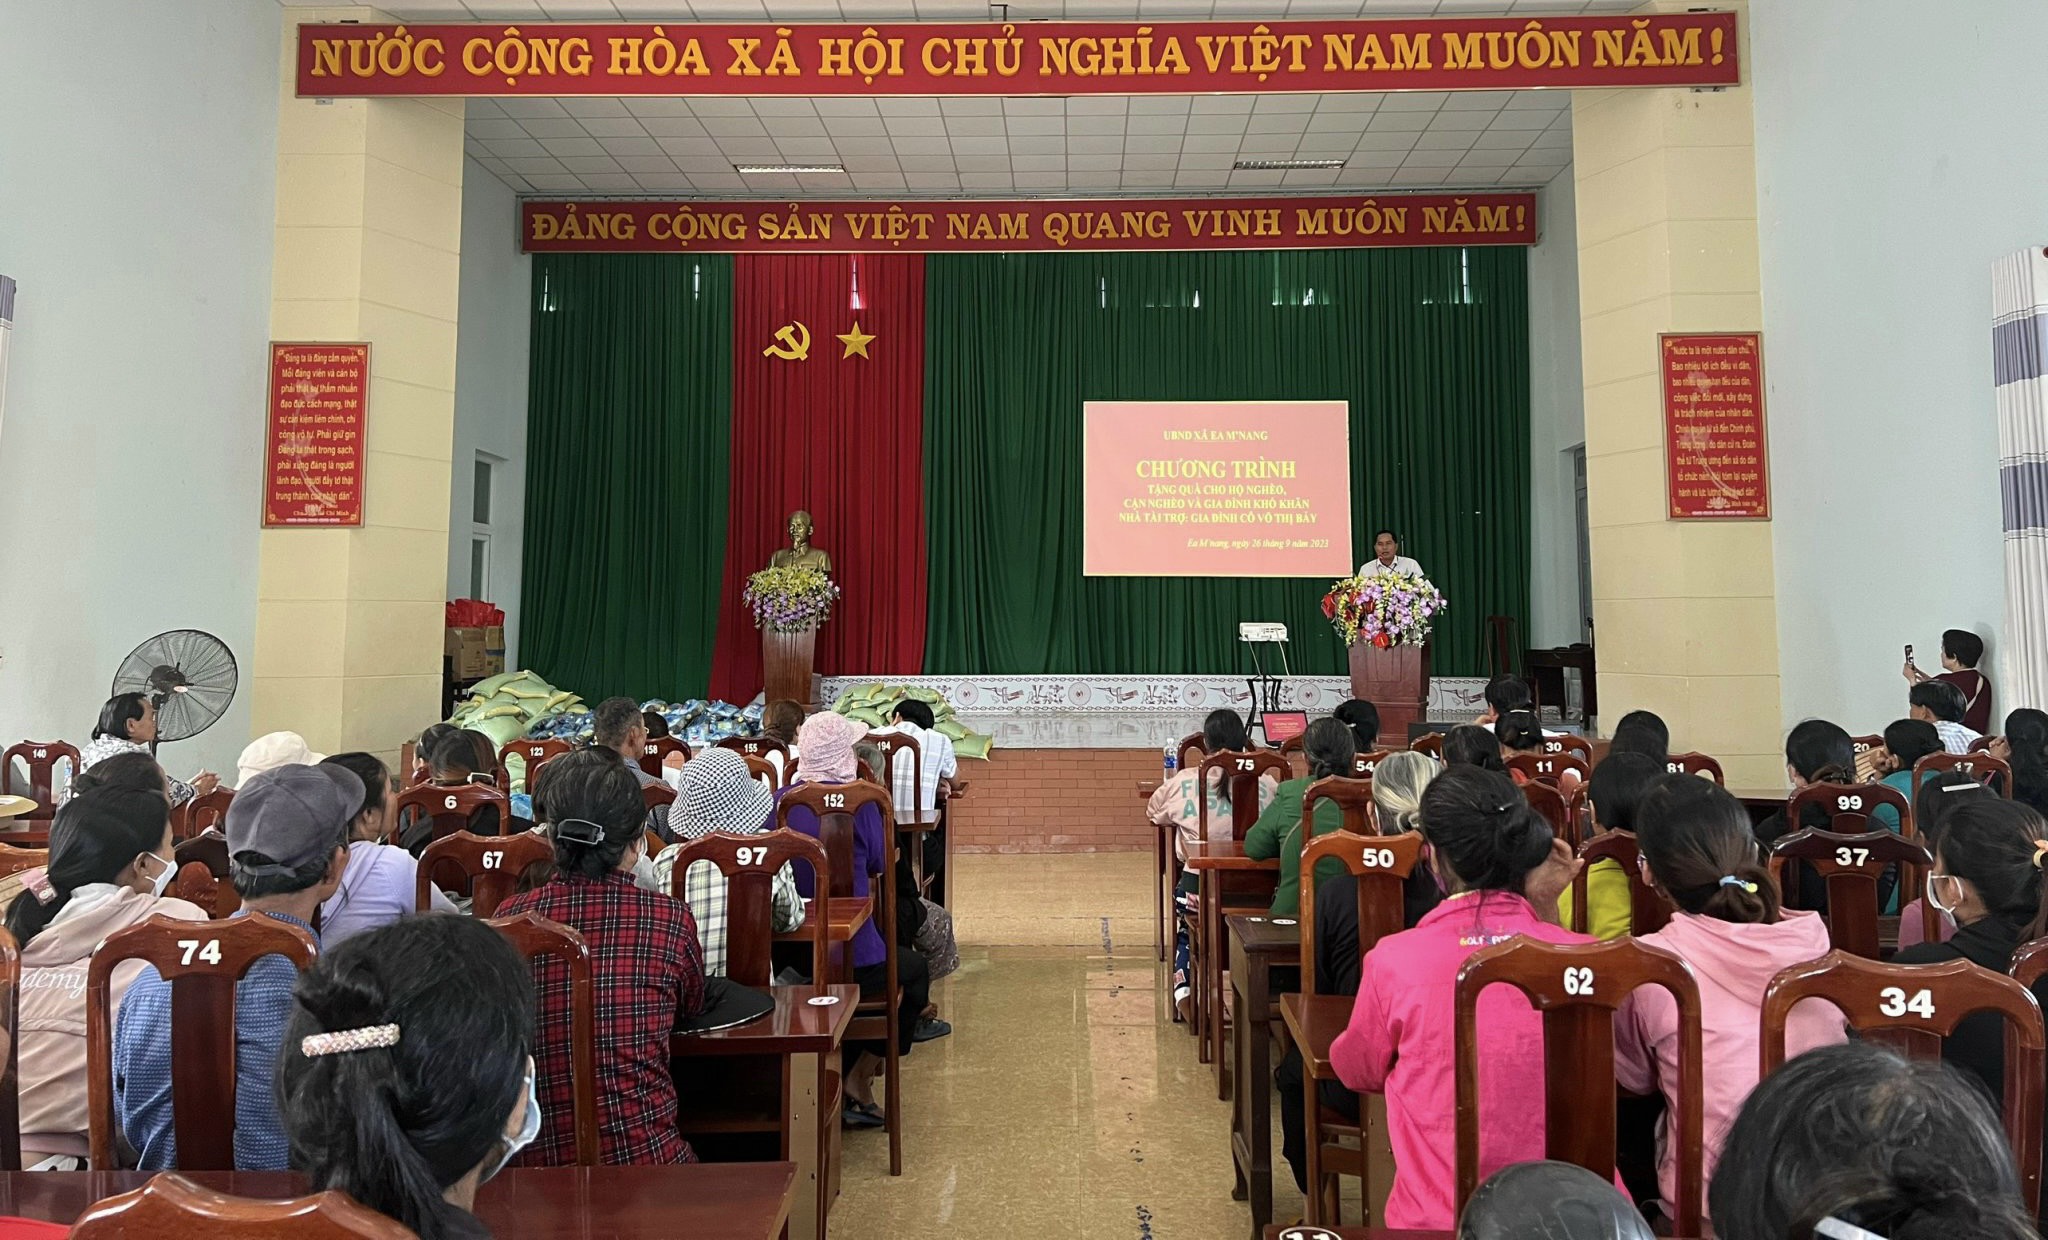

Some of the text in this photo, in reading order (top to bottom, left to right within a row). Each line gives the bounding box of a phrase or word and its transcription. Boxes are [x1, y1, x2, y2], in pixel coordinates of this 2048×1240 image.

[311, 26, 446, 77] NƯỚC
[462, 26, 594, 86] CỘNG
[607, 26, 711, 76] HÒA
[727, 27, 800, 76] XÃ
[818, 27, 904, 85] HỘI
[921, 24, 1024, 76] CHỦ
[1039, 26, 1191, 76] NGHĨA
[1195, 24, 1313, 82] VIỆT
[1323, 32, 1432, 72] NAM
[1443, 20, 1582, 71] MUÔN
[532, 203, 637, 240] ĐẢNG
[648, 205, 747, 246] CỘNG
[758, 203, 832, 240] SẢN
[844, 205, 934, 246] VIỆT
[946, 213, 1029, 240] NAM
[1043, 210, 1171, 246] QUANG
[1183, 209, 1282, 237] VINH
[1296, 199, 1408, 236] MUÔN
[1163, 430, 1191, 441] UBND
[1210, 430, 1224, 441] EA
[1136, 456, 1296, 479] CHƯƠNG TRÌNH
[529, 746, 544, 757] 123
[644, 744, 658, 755] 158
[744, 743, 758, 753] 155
[877, 740, 891, 751] 194
[1545, 741, 1562, 752] 30
[1852, 742, 1870, 752] 20
[32, 748, 47, 758] 140
[1234, 759, 1255, 771] 75
[1355, 760, 1376, 772] 54
[1536, 761, 1553, 773] 11
[1666, 762, 1684, 774] 81
[1953, 761, 1974, 774] 17
[444, 795, 458, 809] 6
[823, 793, 844, 808] 152
[1837, 795, 1863, 810] 99
[482, 851, 503, 869] 67
[736, 846, 768, 866] 97
[1362, 848, 1395, 868] 50
[1835, 846, 1869, 867] 37
[177, 939, 222, 966] 74
[1563, 966, 1594, 995] 62
[1879, 987, 1936, 1019] 34
